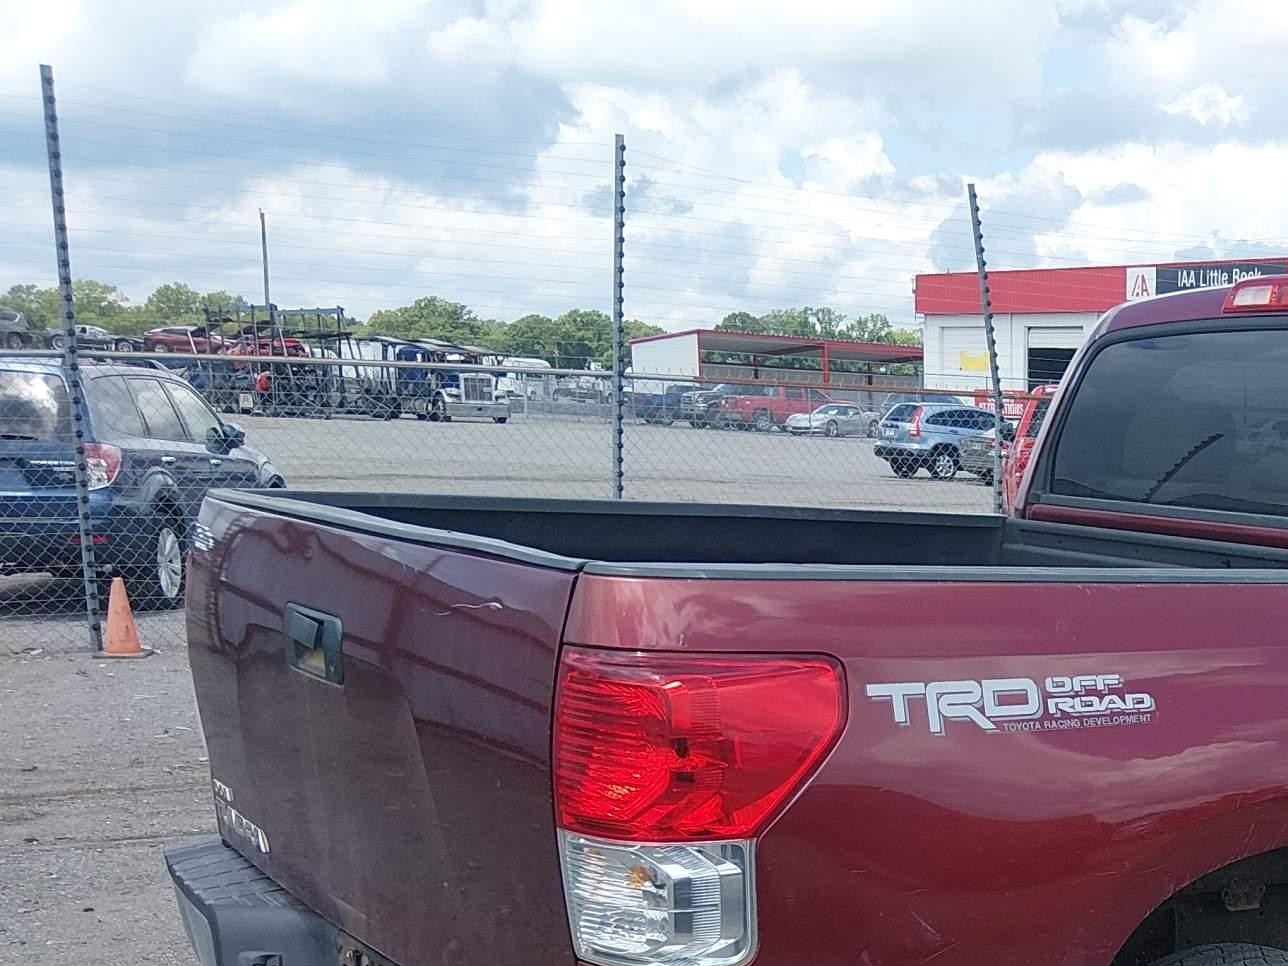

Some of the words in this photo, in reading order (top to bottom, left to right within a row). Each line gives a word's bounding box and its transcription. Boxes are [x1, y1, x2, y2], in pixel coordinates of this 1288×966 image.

[1177, 269, 1196, 288] IAA
[1199, 268, 1229, 287] Little
[1045, 673, 1122, 694] OFF
[866, 677, 1044, 735] TRD
[1047, 693, 1154, 716] ROAD
[1002, 720, 1042, 732] TOYOTA
[1043, 718, 1082, 730] RACING
[1083, 713, 1152, 728] DEVELOPMENT
